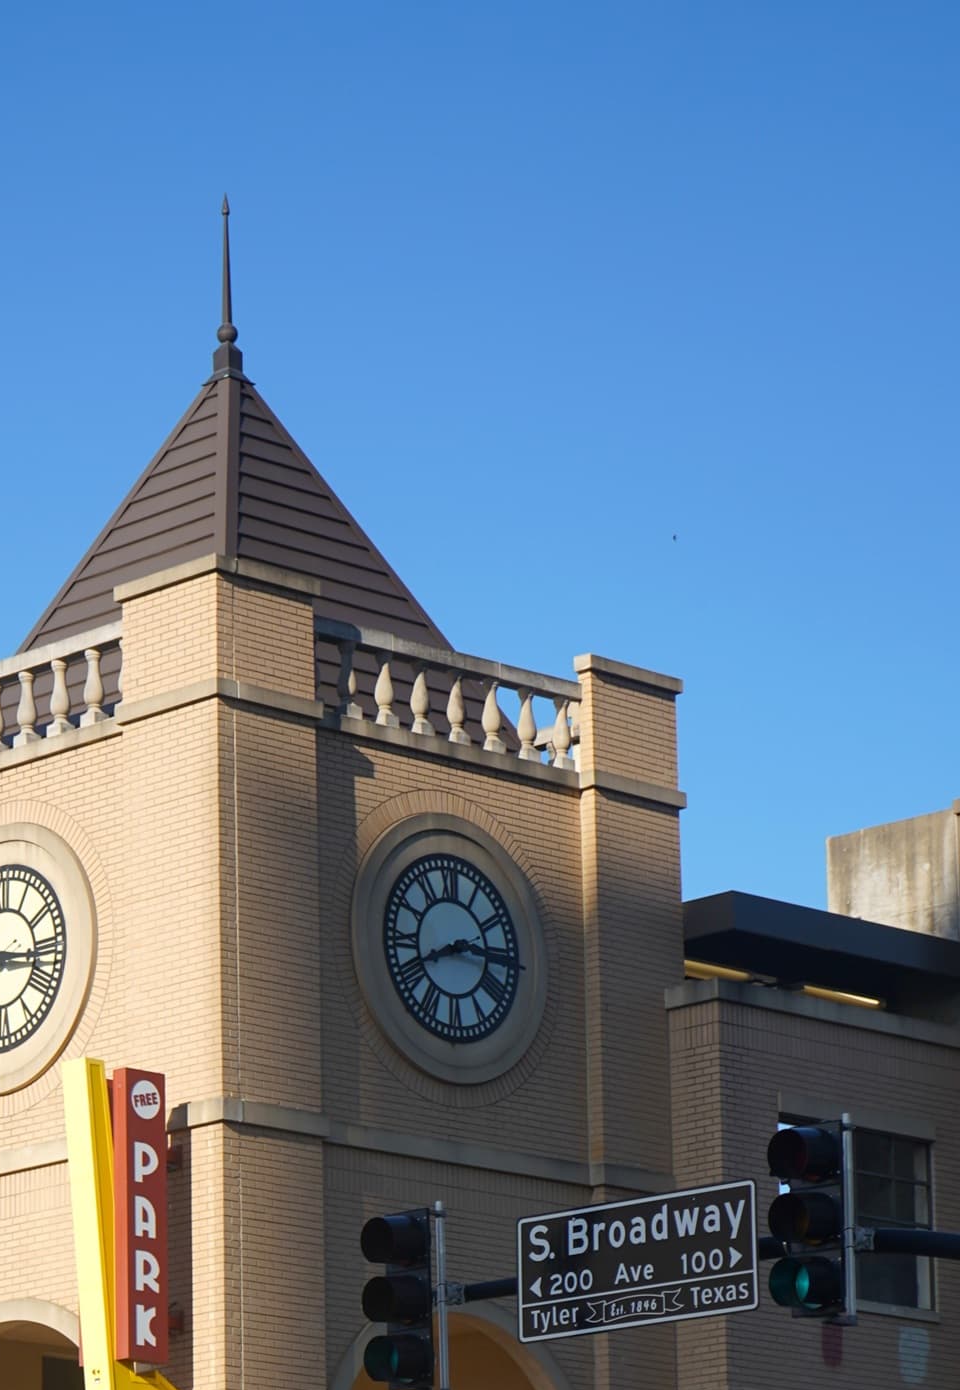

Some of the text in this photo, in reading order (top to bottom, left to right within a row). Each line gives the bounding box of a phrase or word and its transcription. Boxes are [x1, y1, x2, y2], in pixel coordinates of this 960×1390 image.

[133, 1092, 158, 1108] FREE
[133, 1141, 160, 1347] PARK
[528, 1199, 746, 1262] S. Broadway
[549, 1248, 724, 1296] 200 Ave 100
[530, 1281, 749, 1334] Tyler Est. 1846 Texas
